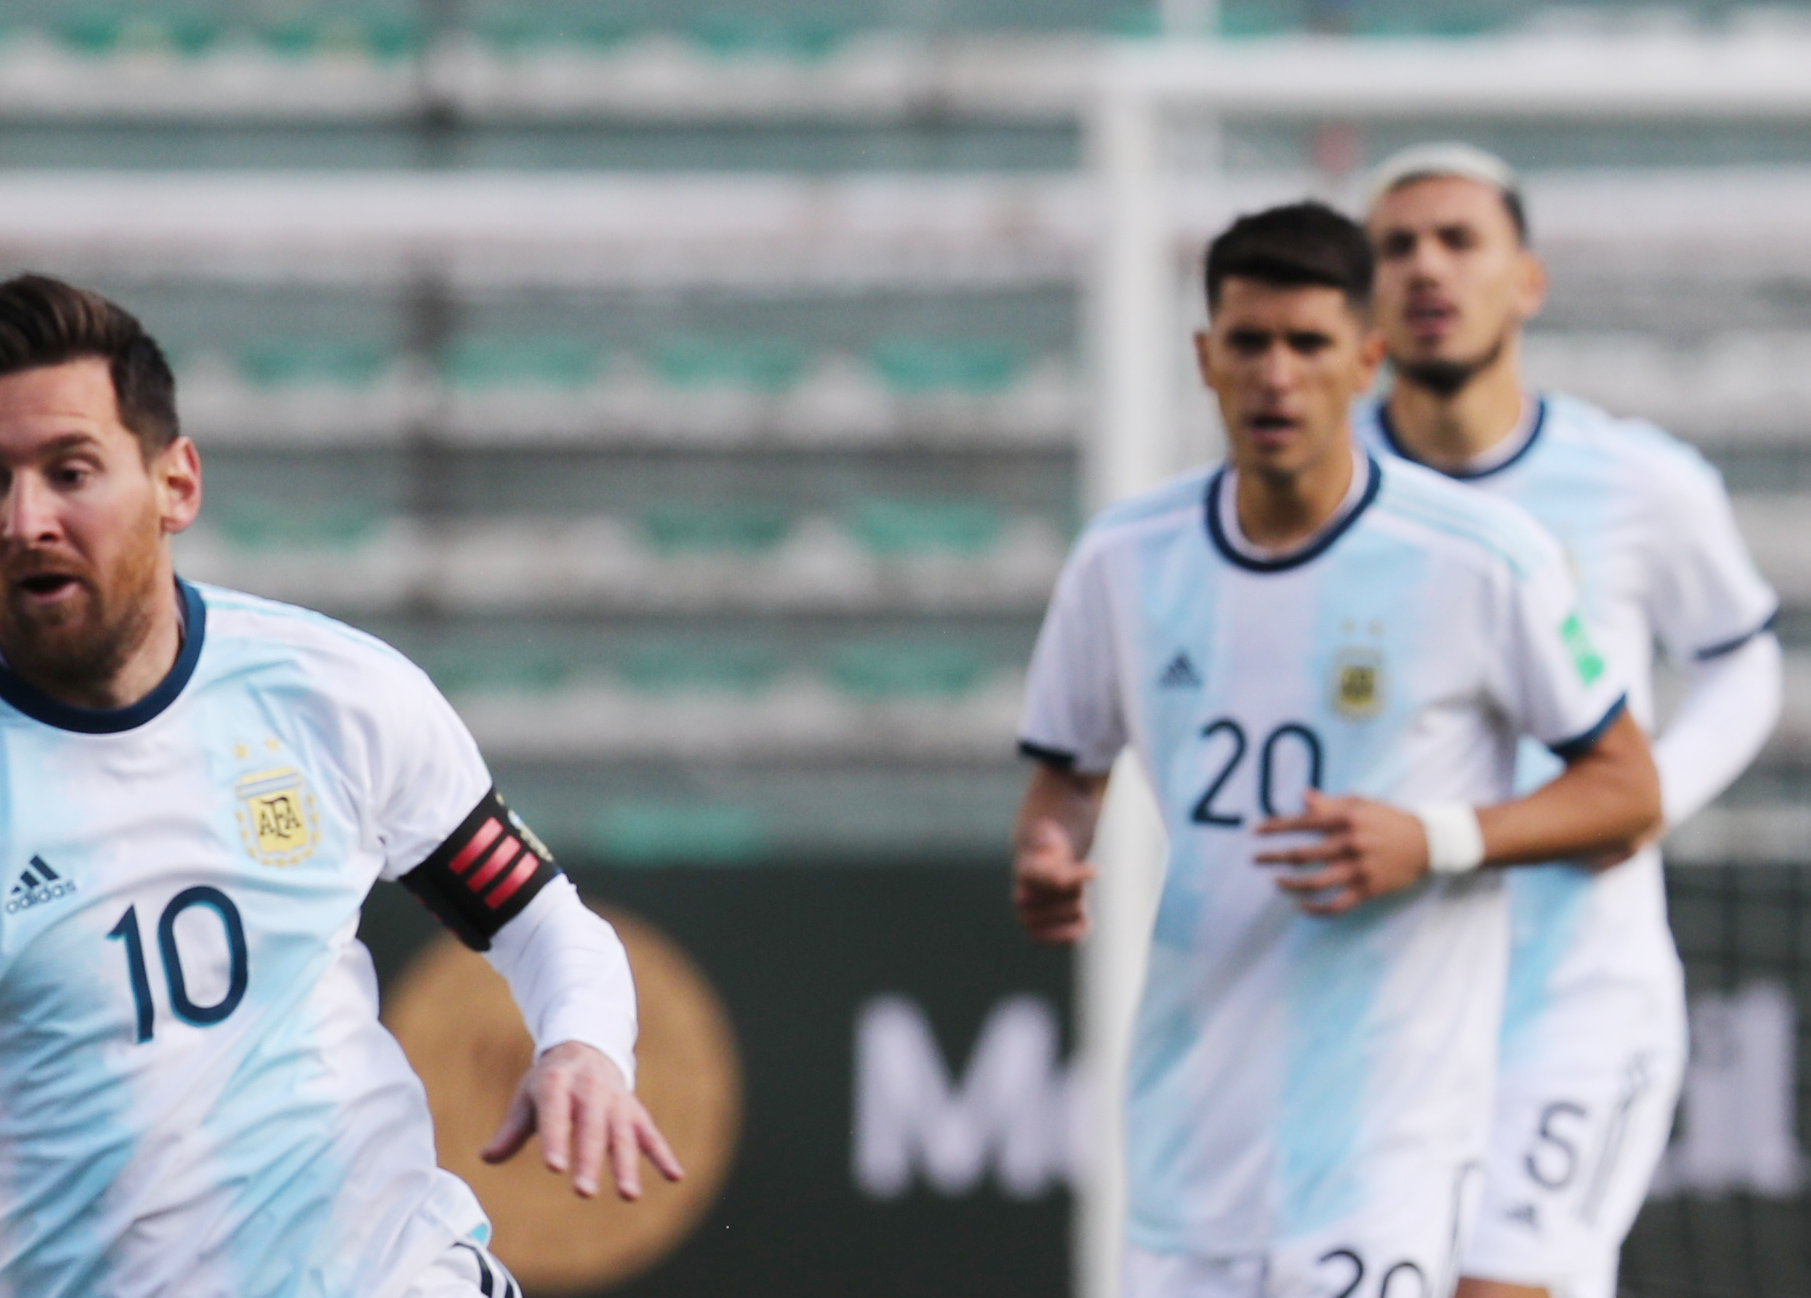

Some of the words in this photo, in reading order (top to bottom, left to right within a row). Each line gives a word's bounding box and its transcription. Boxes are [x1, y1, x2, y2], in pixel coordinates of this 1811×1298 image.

[1191, 715, 1324, 828] 20
[4, 879, 77, 914] adidas
[105, 884, 248, 1046] 10
